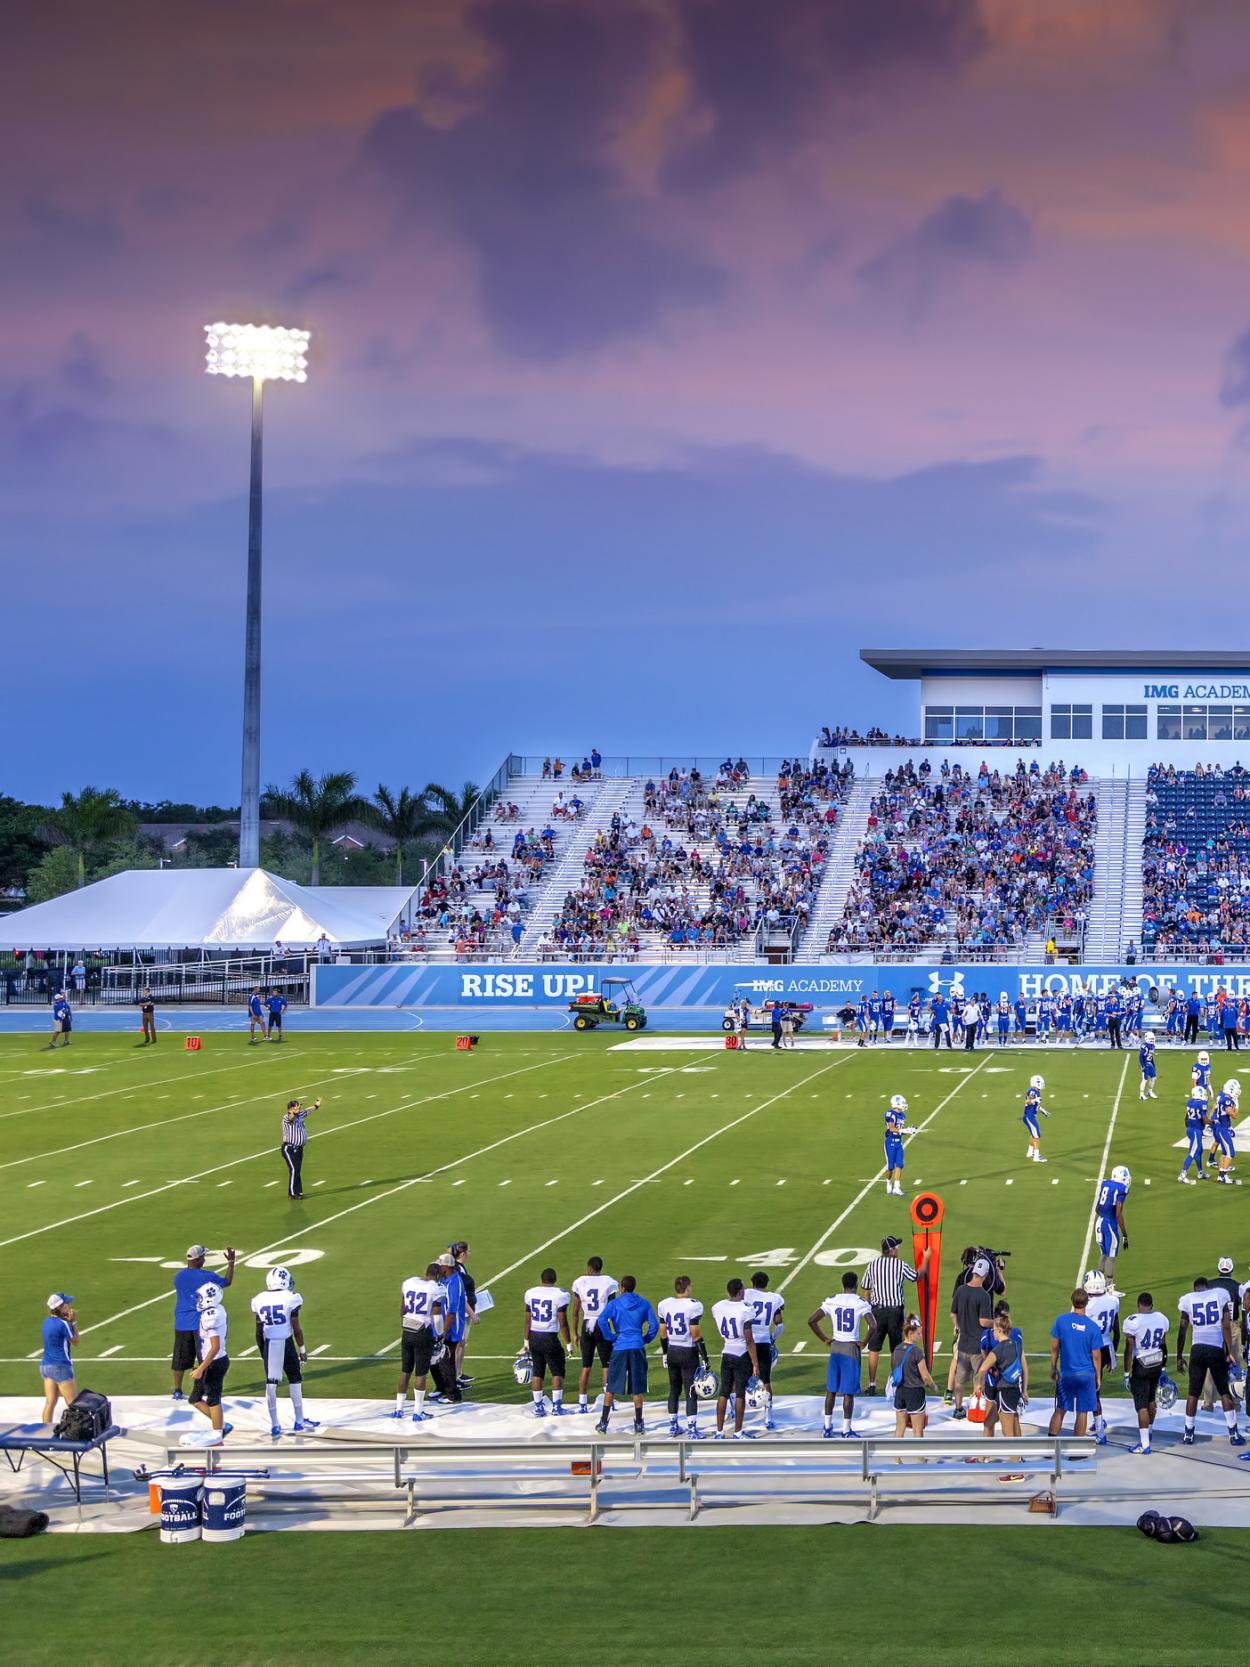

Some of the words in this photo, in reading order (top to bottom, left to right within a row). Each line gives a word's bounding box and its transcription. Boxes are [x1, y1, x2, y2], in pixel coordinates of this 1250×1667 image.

[1143, 685, 1179, 698] IMG
[461, 974, 534, 998] RISE
[543, 974, 596, 997] UP!
[752, 979, 784, 992] IMG
[788, 979, 864, 992] ACADEMY
[1019, 974, 1121, 1000] HOME
[456, 1036, 468, 1048] 20
[726, 1035, 737, 1046] 30
[1100, 1186, 1109, 1206] 8
[734, 1247, 885, 1267] 40
[405, 1290, 428, 1315] 32
[530, 1298, 553, 1323] 53
[586, 1288, 600, 1312] 3
[259, 1304, 287, 1326] 35
[665, 1312, 688, 1336] 43
[752, 1301, 774, 1327] 21
[834, 1307, 856, 1333] 19
[1097, 1309, 1116, 1335] 31
[1192, 1300, 1220, 1327] 56
[720, 1316, 739, 1340] 41
[1140, 1327, 1165, 1352] 48
[160, 1511, 198, 1522] OOTBALL
